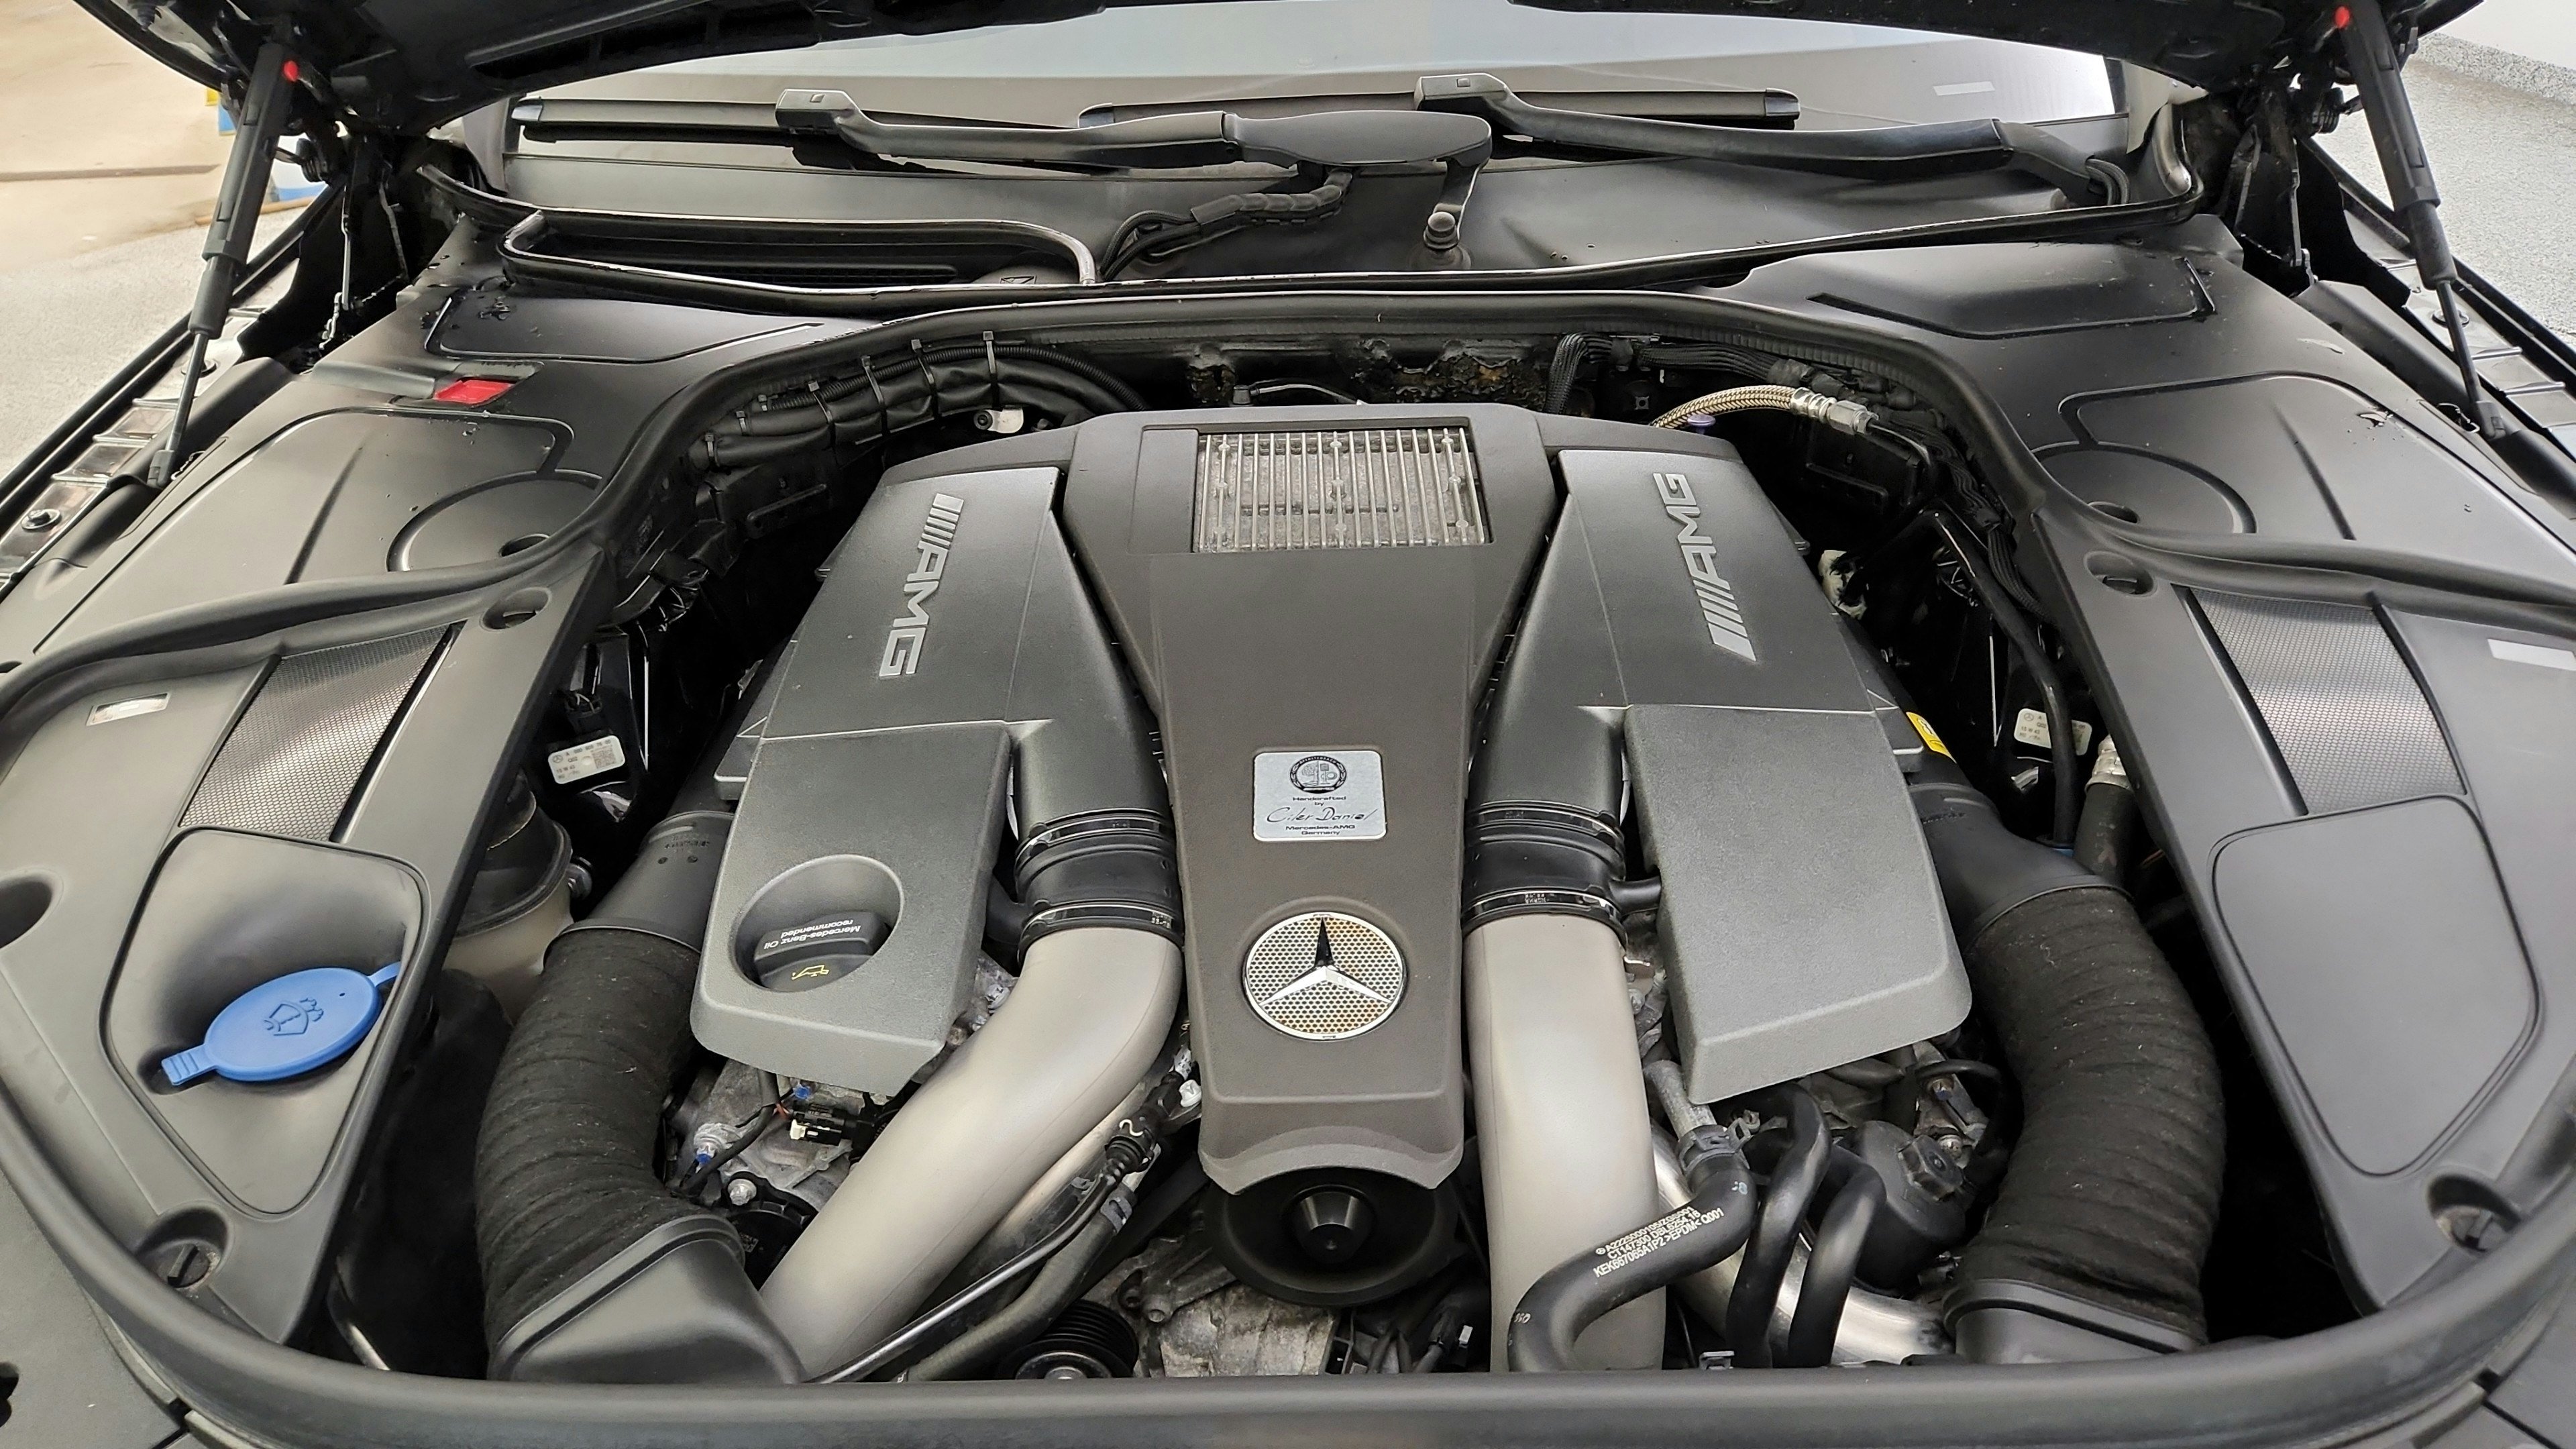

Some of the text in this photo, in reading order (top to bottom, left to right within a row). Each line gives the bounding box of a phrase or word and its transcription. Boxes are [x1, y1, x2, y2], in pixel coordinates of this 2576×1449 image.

[879, 540, 949, 677] AMG
[1315, 806, 1378, 821] Daniel
[763, 925, 861, 950] Mercedes-Benz Oil
[780, 920, 854, 939] recommended
[1701, 1207, 1725, 1225] Q001
[1607, 1234, 1652, 1260] CT147300
